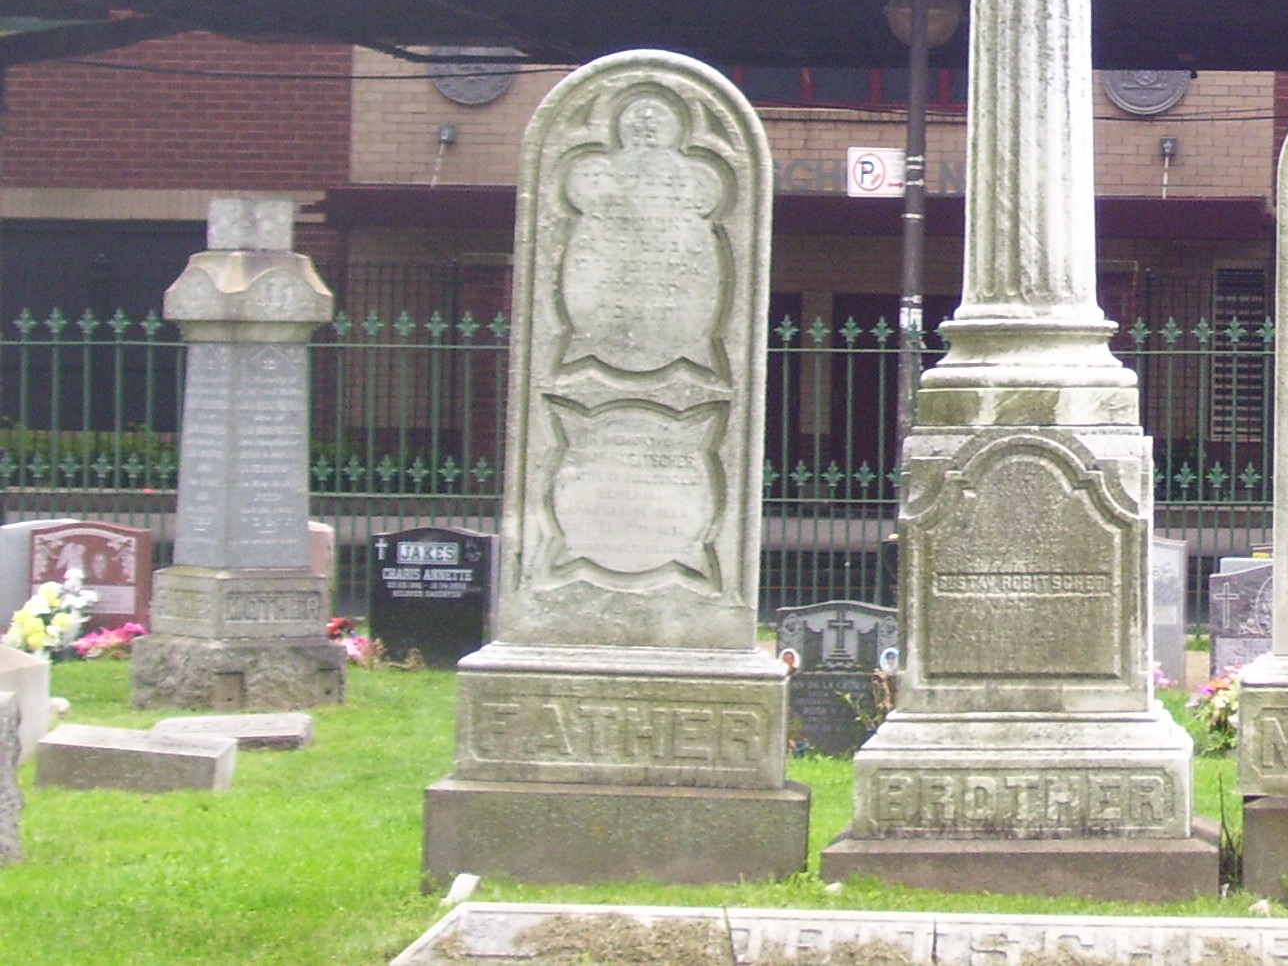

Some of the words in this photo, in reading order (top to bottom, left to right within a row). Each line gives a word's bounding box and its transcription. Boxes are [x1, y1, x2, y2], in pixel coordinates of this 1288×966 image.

[400, 544, 455, 562] JAKES
[423, 568, 473, 582] ANNETTE
[938, 575, 998, 591] GUSTAV
[478, 702, 762, 762] FATHER
[876, 774, 1167, 822] BROTHER
